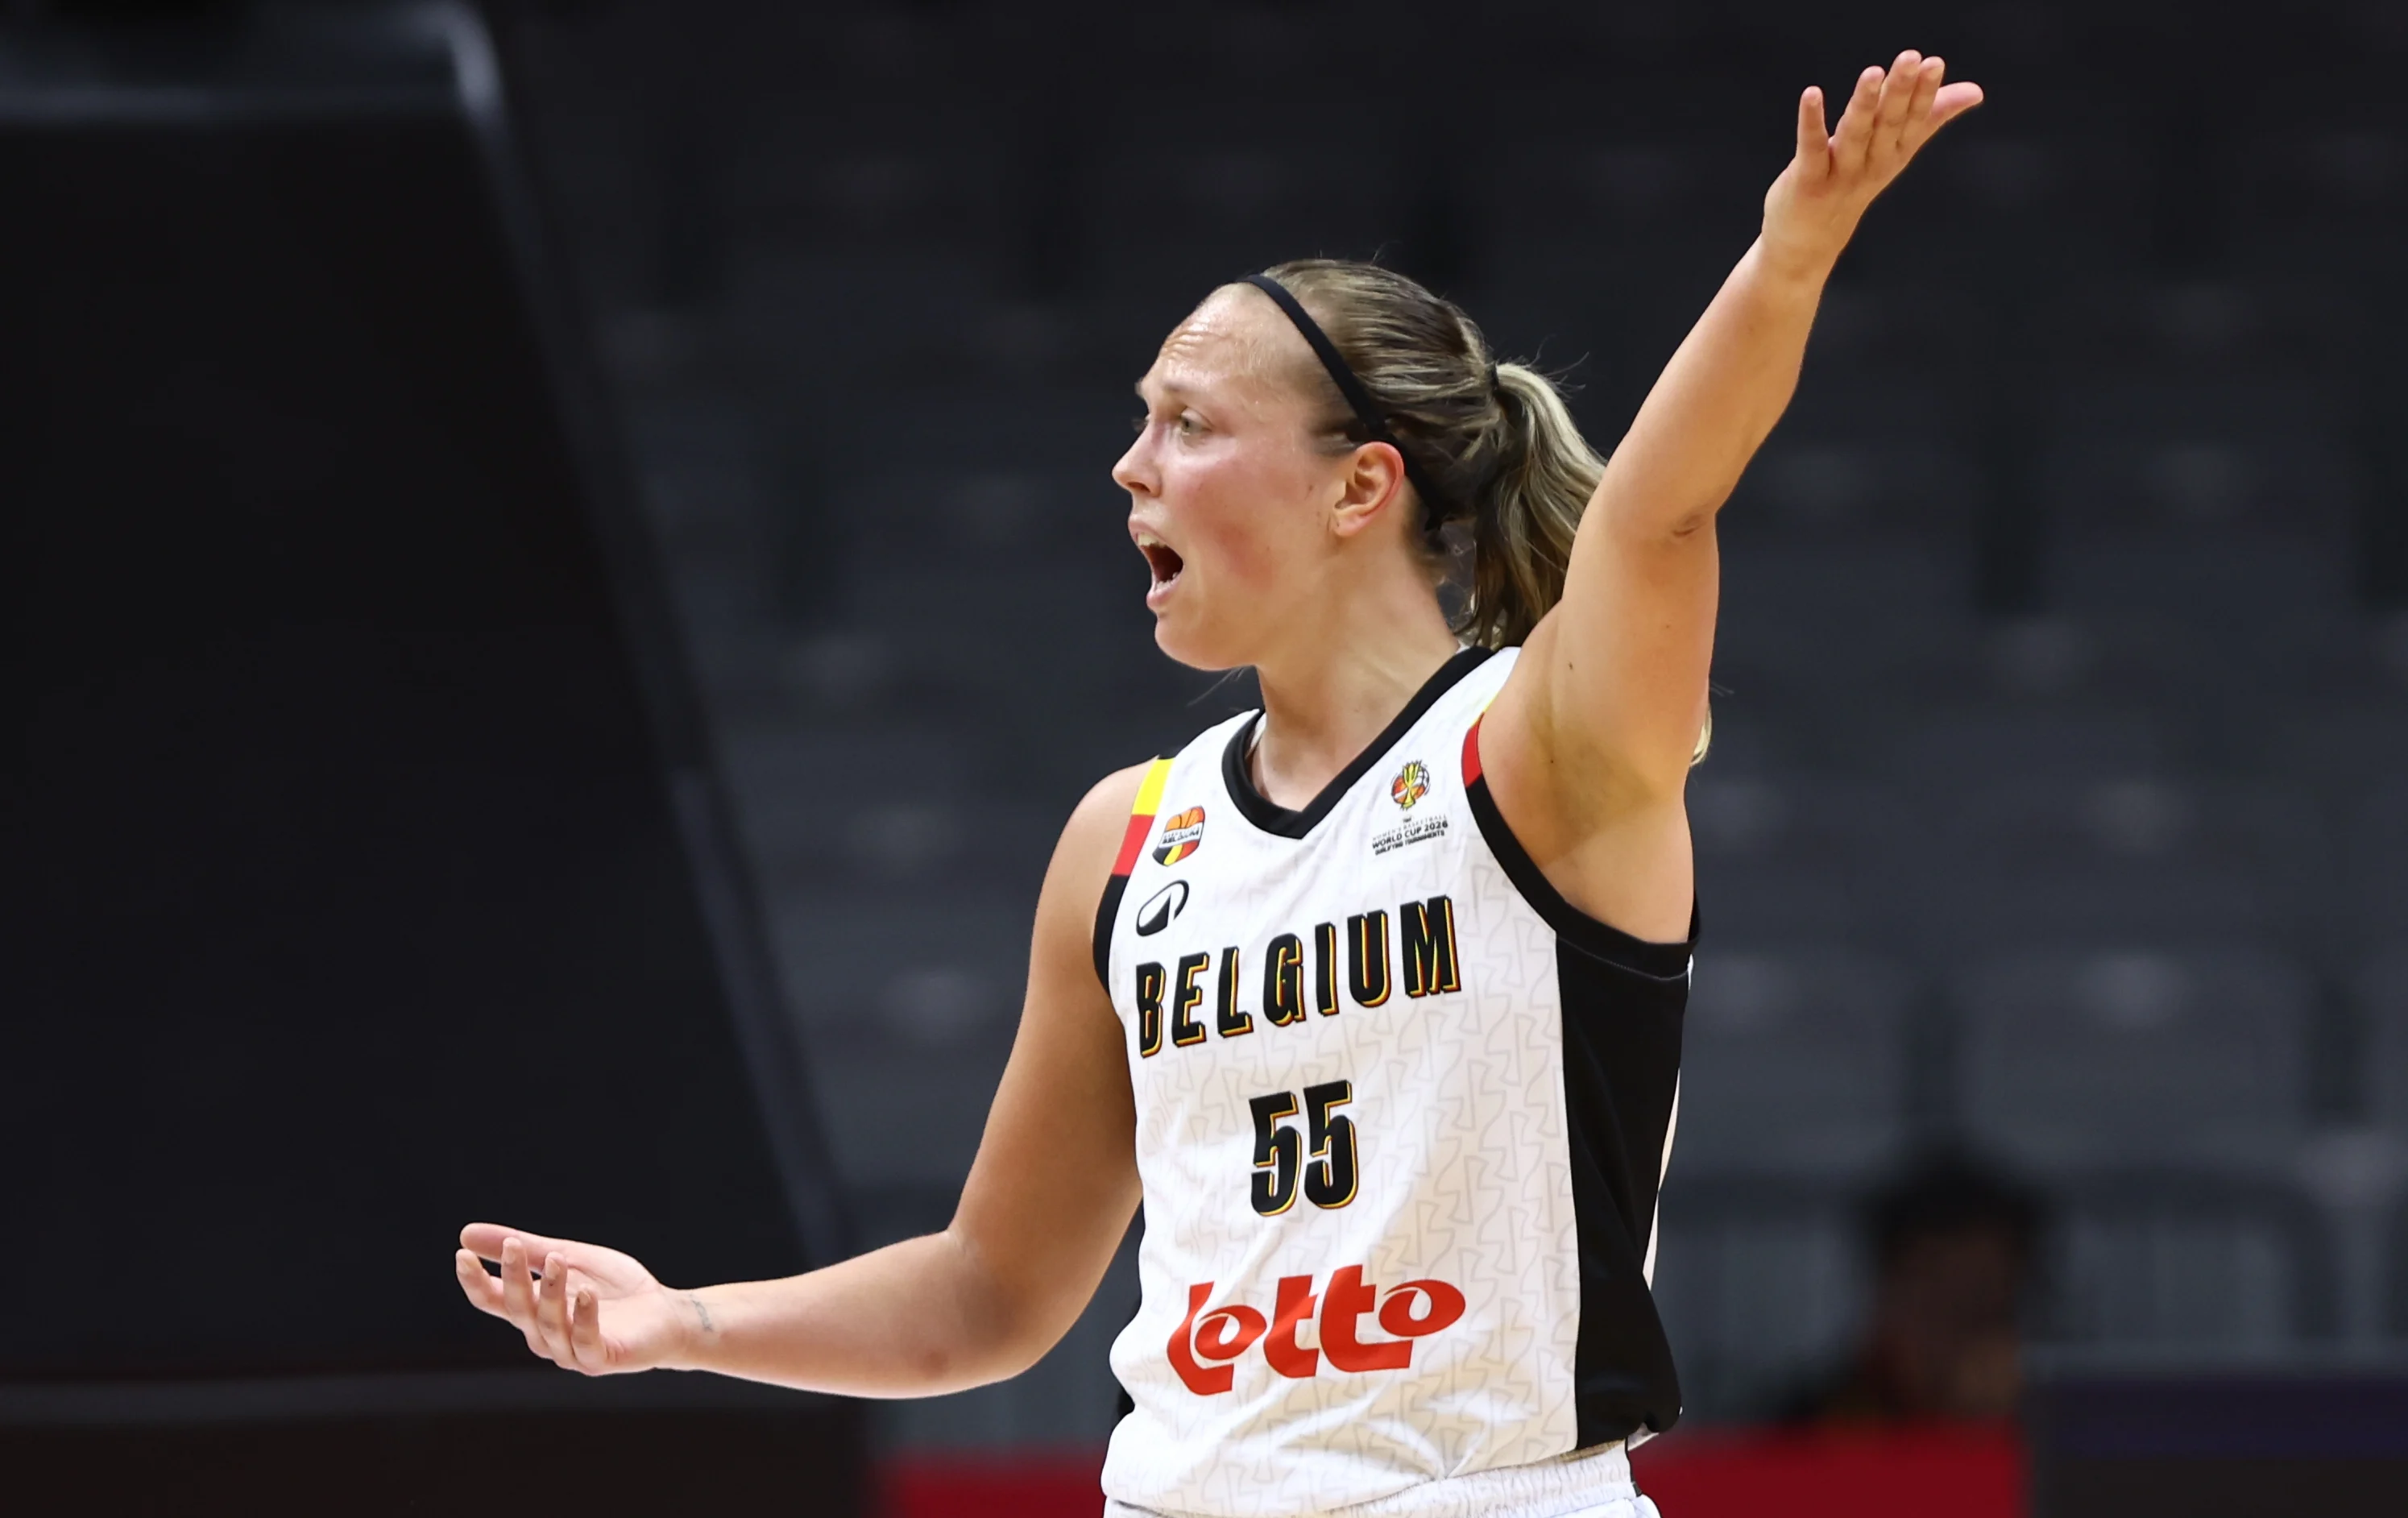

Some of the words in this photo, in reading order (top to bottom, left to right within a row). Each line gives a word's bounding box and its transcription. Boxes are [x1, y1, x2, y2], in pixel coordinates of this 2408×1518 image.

[1372, 833, 1402, 849] WORLD
[1404, 827, 1422, 838] CUP
[1424, 820, 1448, 832] 2026
[1135, 894, 1462, 1059] BELGIUM
[1248, 1078, 1361, 1217] 55
